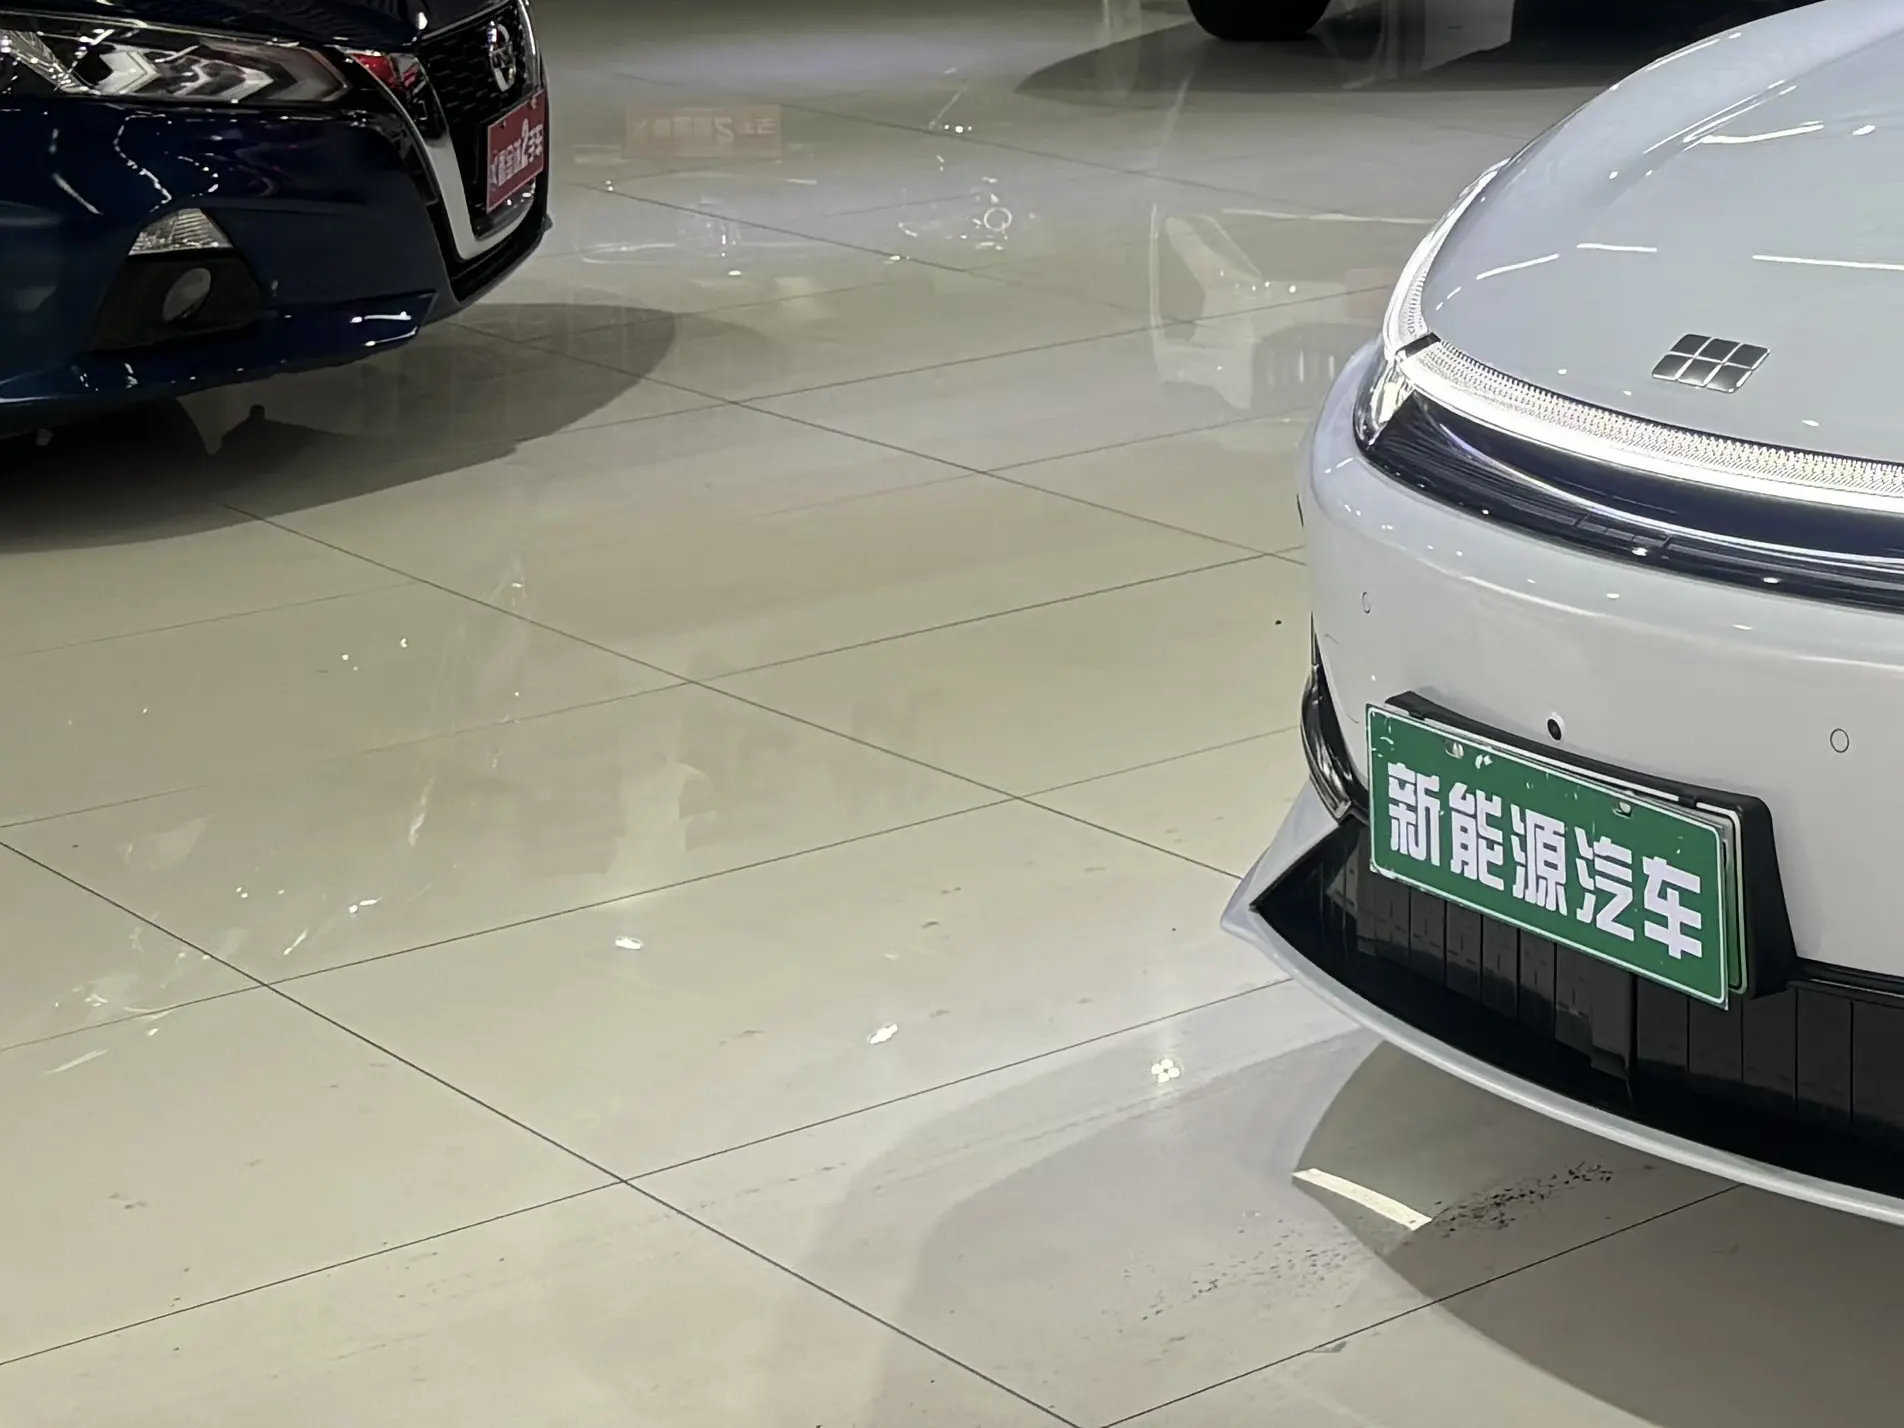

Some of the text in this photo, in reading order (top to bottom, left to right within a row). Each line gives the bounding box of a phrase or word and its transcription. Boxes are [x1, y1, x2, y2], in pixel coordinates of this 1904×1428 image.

[1386, 761, 1703, 960] 新能源汽车
